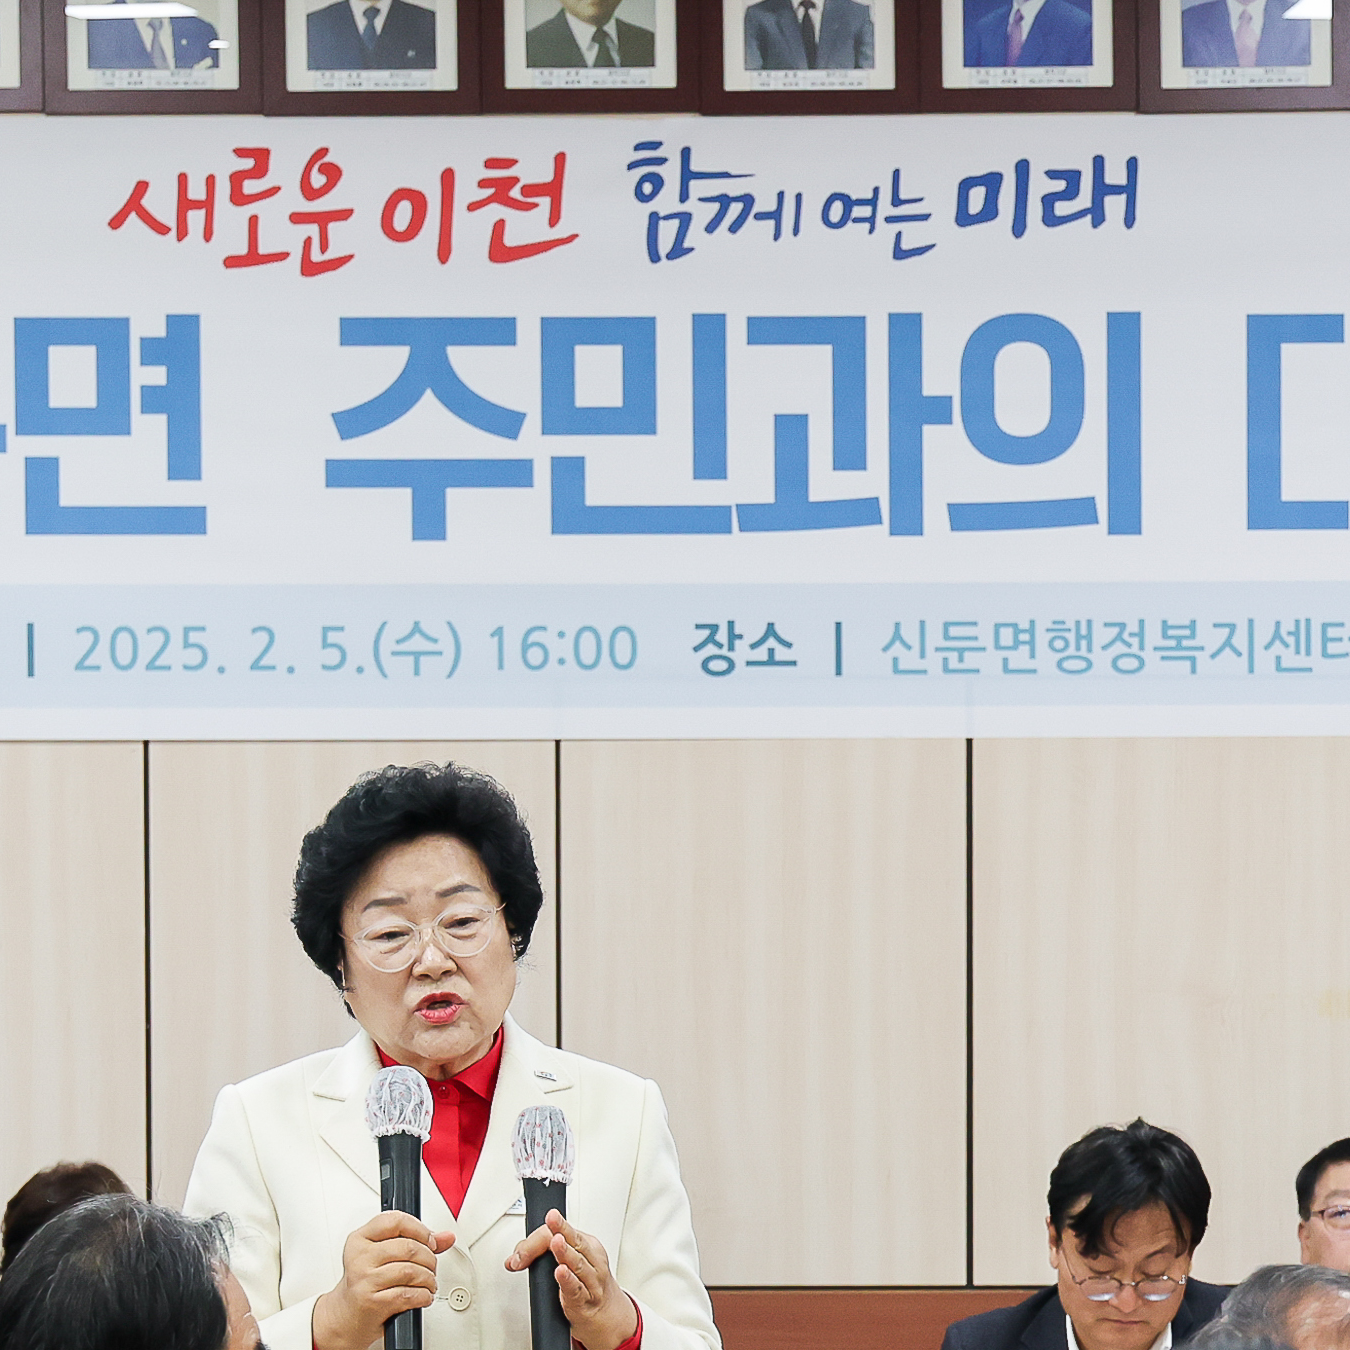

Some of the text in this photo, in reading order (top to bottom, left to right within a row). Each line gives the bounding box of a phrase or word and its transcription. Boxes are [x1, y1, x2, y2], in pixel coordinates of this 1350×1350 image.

[108, 140, 1138, 277] 새로운 이천 함께 여는 미래
[325, 311, 1142, 541] 주민과의
[75, 626, 225, 674] 2025.
[250, 626, 295, 674] 2.
[322, 621, 461, 679] 5.(수)
[490, 626, 637, 672] 16:00
[693, 620, 797, 678] 장소
